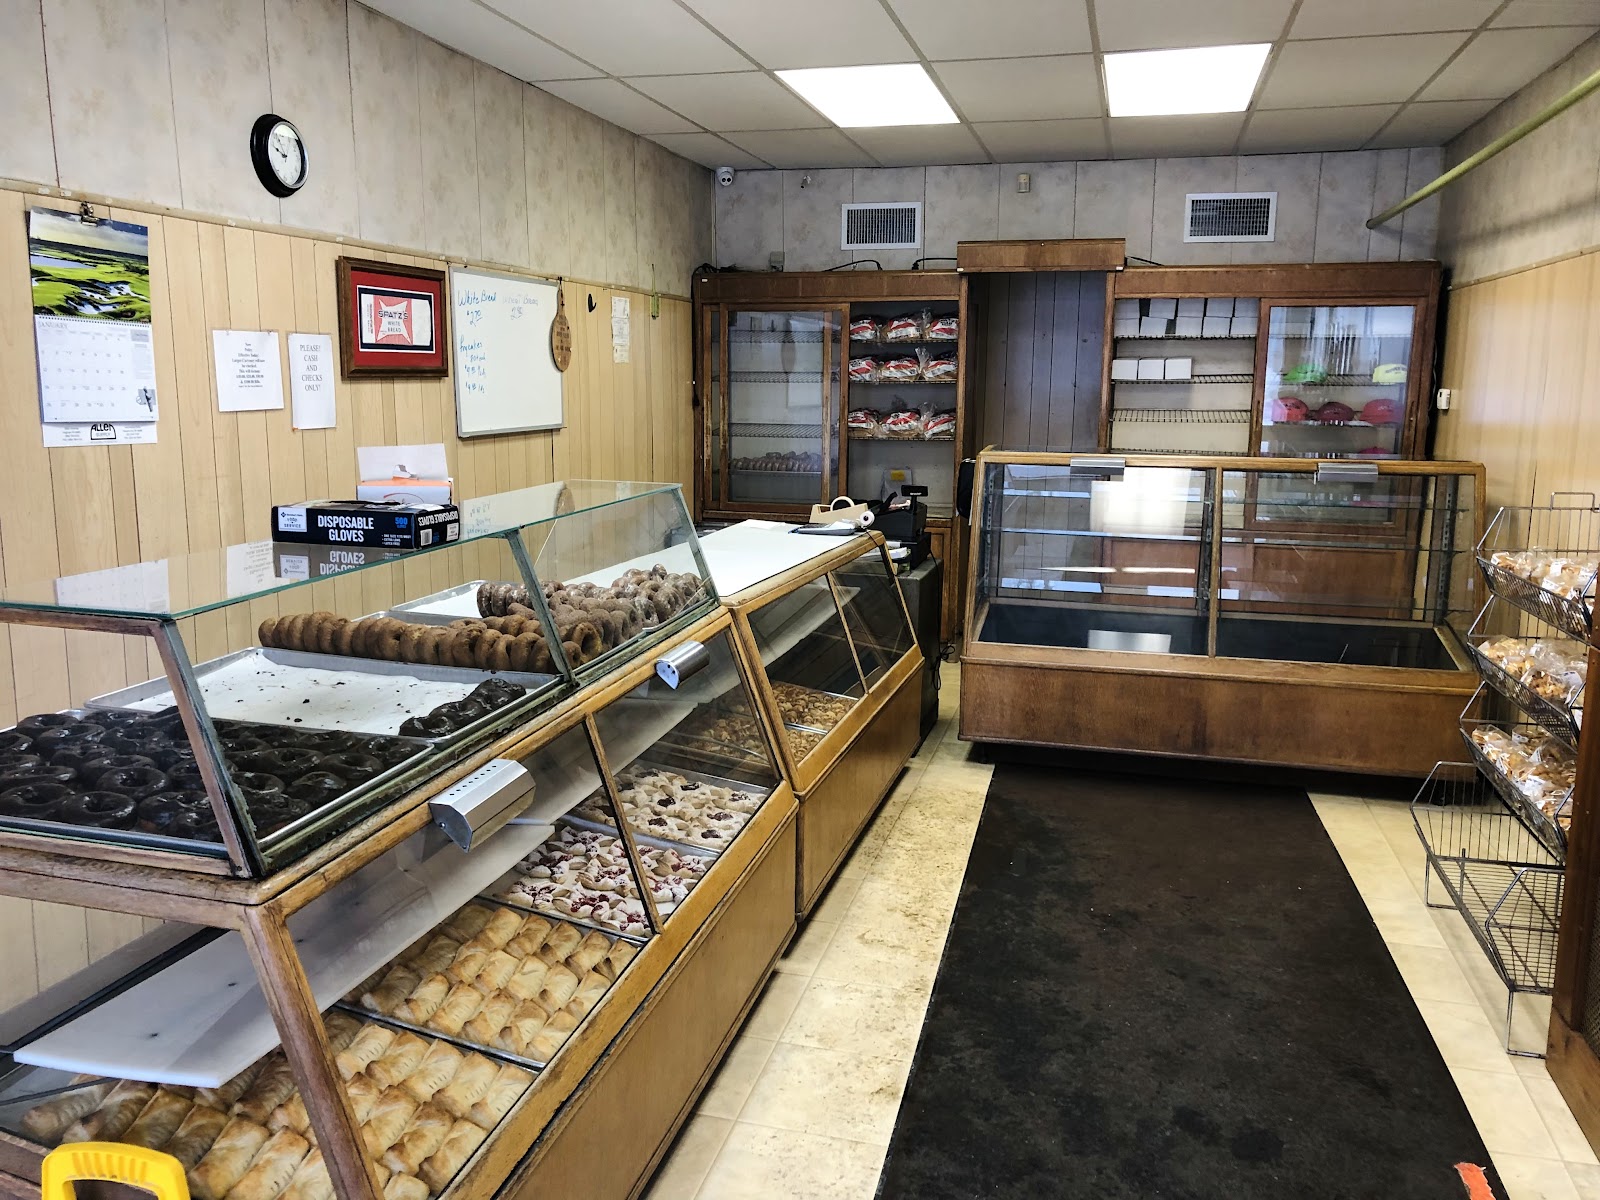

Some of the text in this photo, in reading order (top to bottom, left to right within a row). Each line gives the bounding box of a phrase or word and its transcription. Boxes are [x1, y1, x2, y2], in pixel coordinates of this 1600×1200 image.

[458, 289, 497, 307] White Bread
[378, 310, 409, 320] SPATZ'S
[38, 320, 68, 330] JANUARY
[299, 344, 321, 352] PLEASE!
[303, 354, 319, 362] CASH
[301, 374, 323, 382] CHECKS
[317, 515, 375, 530] DISPOSABLE
[394, 517, 408, 525] 500
[328, 528, 364, 542] GLOVES
